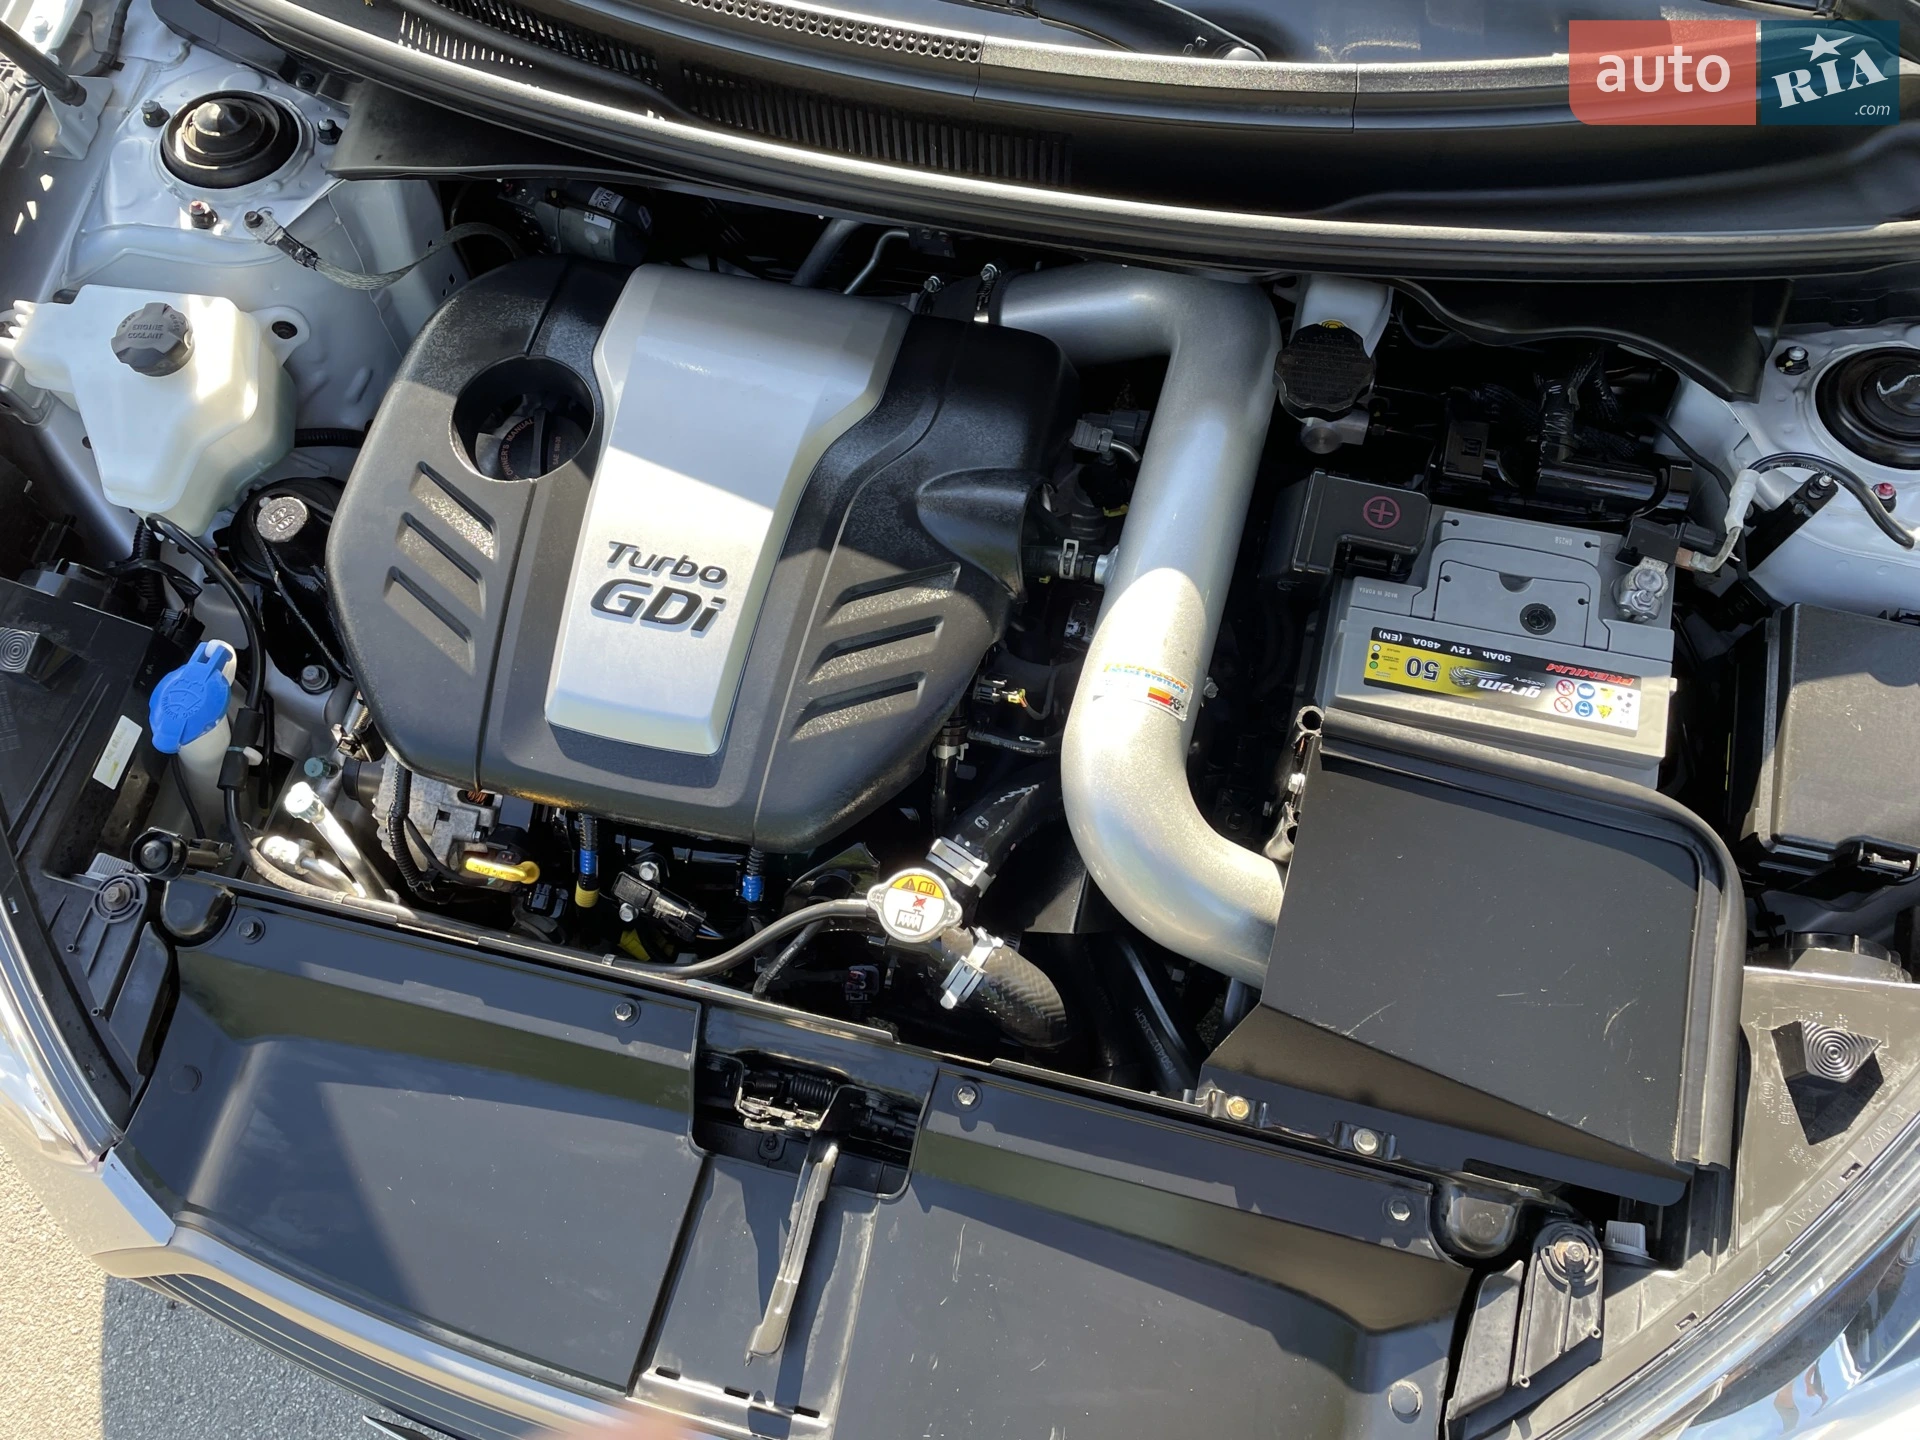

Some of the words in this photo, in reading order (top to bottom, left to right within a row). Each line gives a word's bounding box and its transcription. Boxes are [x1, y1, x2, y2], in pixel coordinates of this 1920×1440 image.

[128, 332, 164, 340] COOLANT
[608, 541, 728, 584] Turbo
[591, 578, 728, 633] GDi
[1378, 630, 1403, 642] (EN)
[1412, 637, 1441, 651] 480A
[1451, 644, 1473, 656] 12V
[1482, 650, 1512, 663] 50Ah
[1404, 656, 1441, 682] 50
[1545, 663, 1635, 686] PREMIUM
